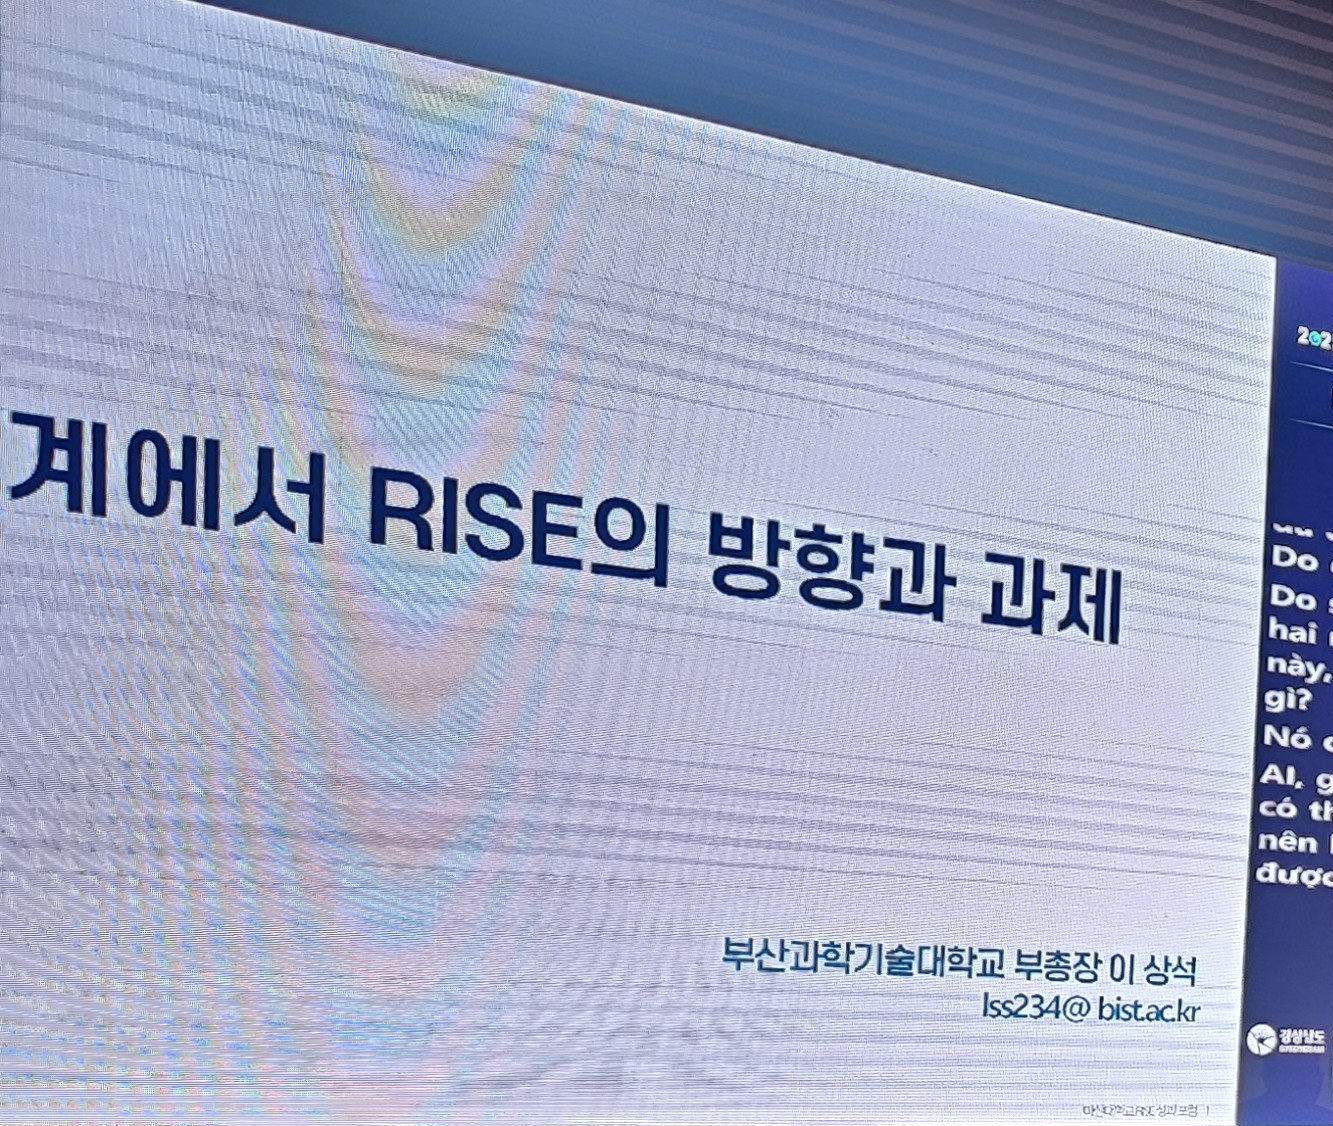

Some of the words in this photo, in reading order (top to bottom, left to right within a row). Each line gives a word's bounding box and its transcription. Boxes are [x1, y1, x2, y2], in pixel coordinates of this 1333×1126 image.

[10, 410, 325, 545] 계에서
[370, 466, 670, 588] RISE의
[708, 511, 957, 623] 방향과
[981, 550, 1122, 646] 과제
[1272, 544, 1319, 571] Do
[1269, 583, 1317, 611] Do
[1268, 616, 1318, 645] hai
[1267, 652, 1332, 684] này,
[1264, 686, 1313, 713] gì?
[1263, 724, 1312, 750] Nó
[1259, 763, 1304, 790] AI,
[1259, 796, 1298, 819] có
[1258, 830, 1318, 855] nên
[722, 936, 1006, 981] 부산과학기술대학교
[1014, 948, 1103, 985] 부총장
[1109, 953, 1134, 985] 이
[1143, 953, 1198, 988] 상석
